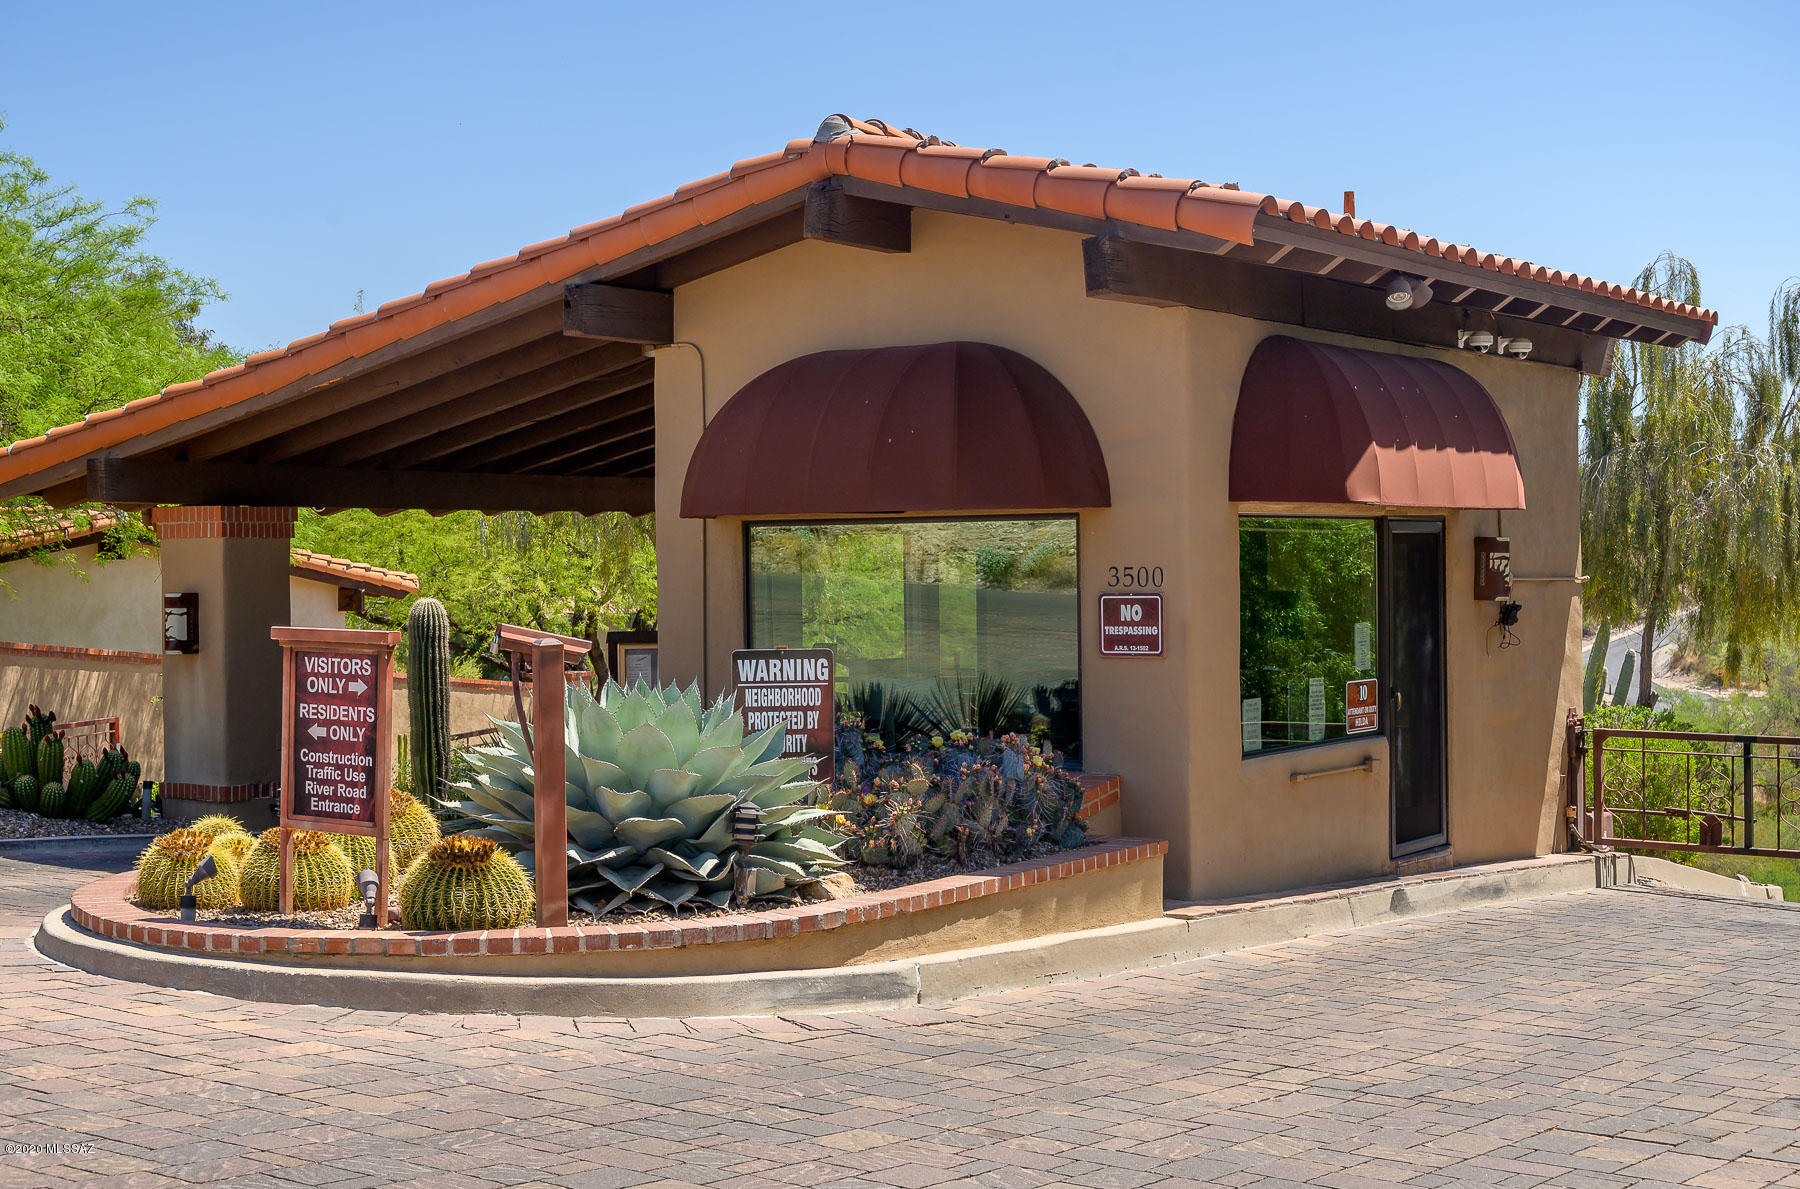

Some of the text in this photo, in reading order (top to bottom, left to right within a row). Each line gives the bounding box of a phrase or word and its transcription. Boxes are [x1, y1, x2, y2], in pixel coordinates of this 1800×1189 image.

[1107, 566, 1164, 588] 3500
[1120, 604, 1143, 622] NO
[1104, 626, 1158, 635] TRESPASSING
[304, 656, 372, 676] VISITORS
[737, 658, 829, 682] WARNING
[307, 676, 346, 694] ONLY
[1359, 684, 1368, 701] 10
[745, 687, 822, 708] NEIGHBORHOOD
[299, 703, 375, 723] RESIDENTS
[807, 711, 820, 729] BY
[329, 725, 366, 742] ONLY
[300, 748, 373, 767] Construction
[306, 765, 366, 783] Traffic Use
[305, 781, 367, 799] River Road
[310, 797, 361, 815] Entrance
